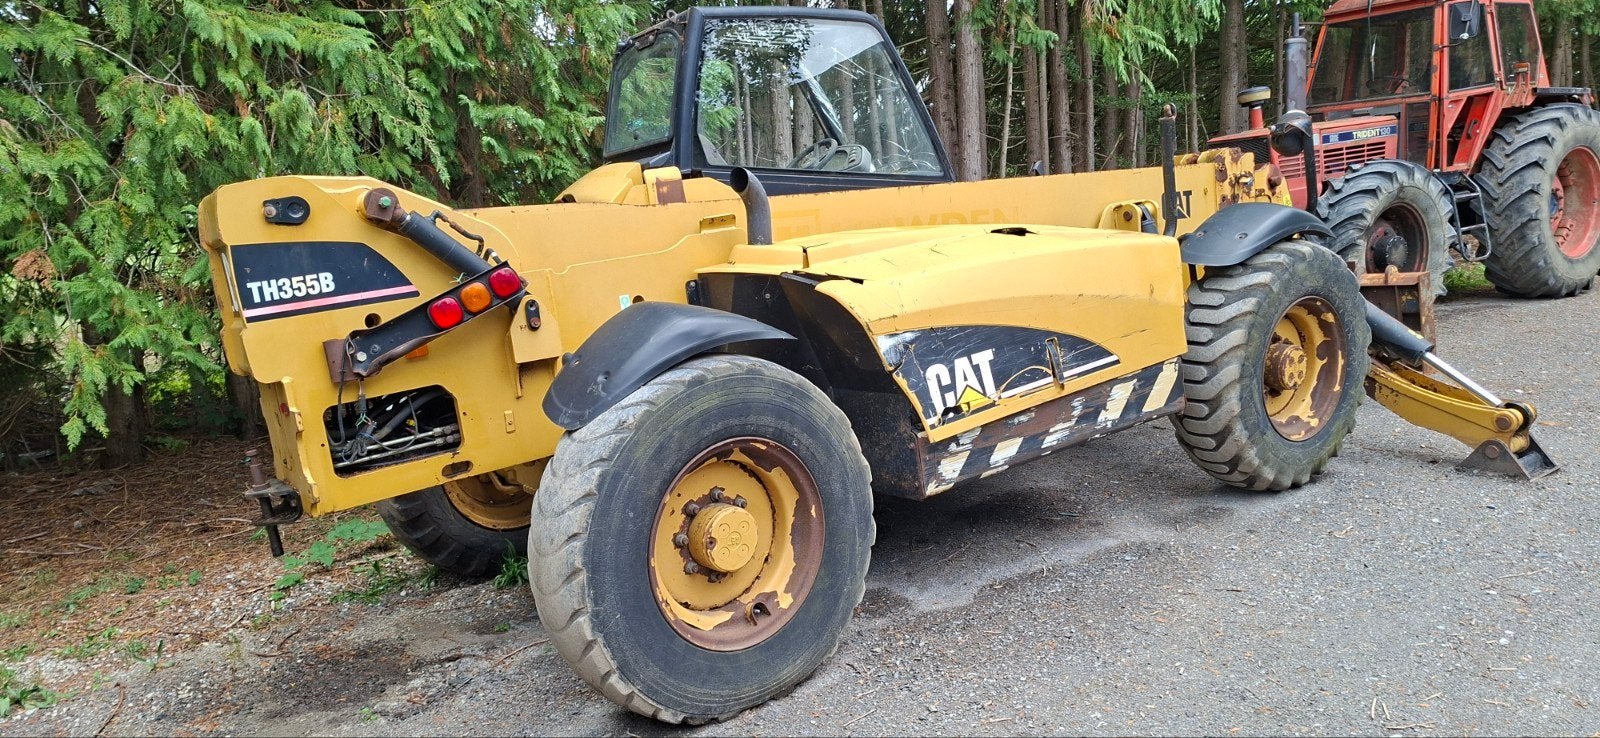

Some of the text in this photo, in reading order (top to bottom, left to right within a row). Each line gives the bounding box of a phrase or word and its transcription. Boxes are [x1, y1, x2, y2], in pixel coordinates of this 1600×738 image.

[1352, 128, 1380, 140] TRIDENT
[1162, 190, 1193, 220] AT
[246, 272, 336, 303] TH355B
[925, 348, 996, 416] CAT
